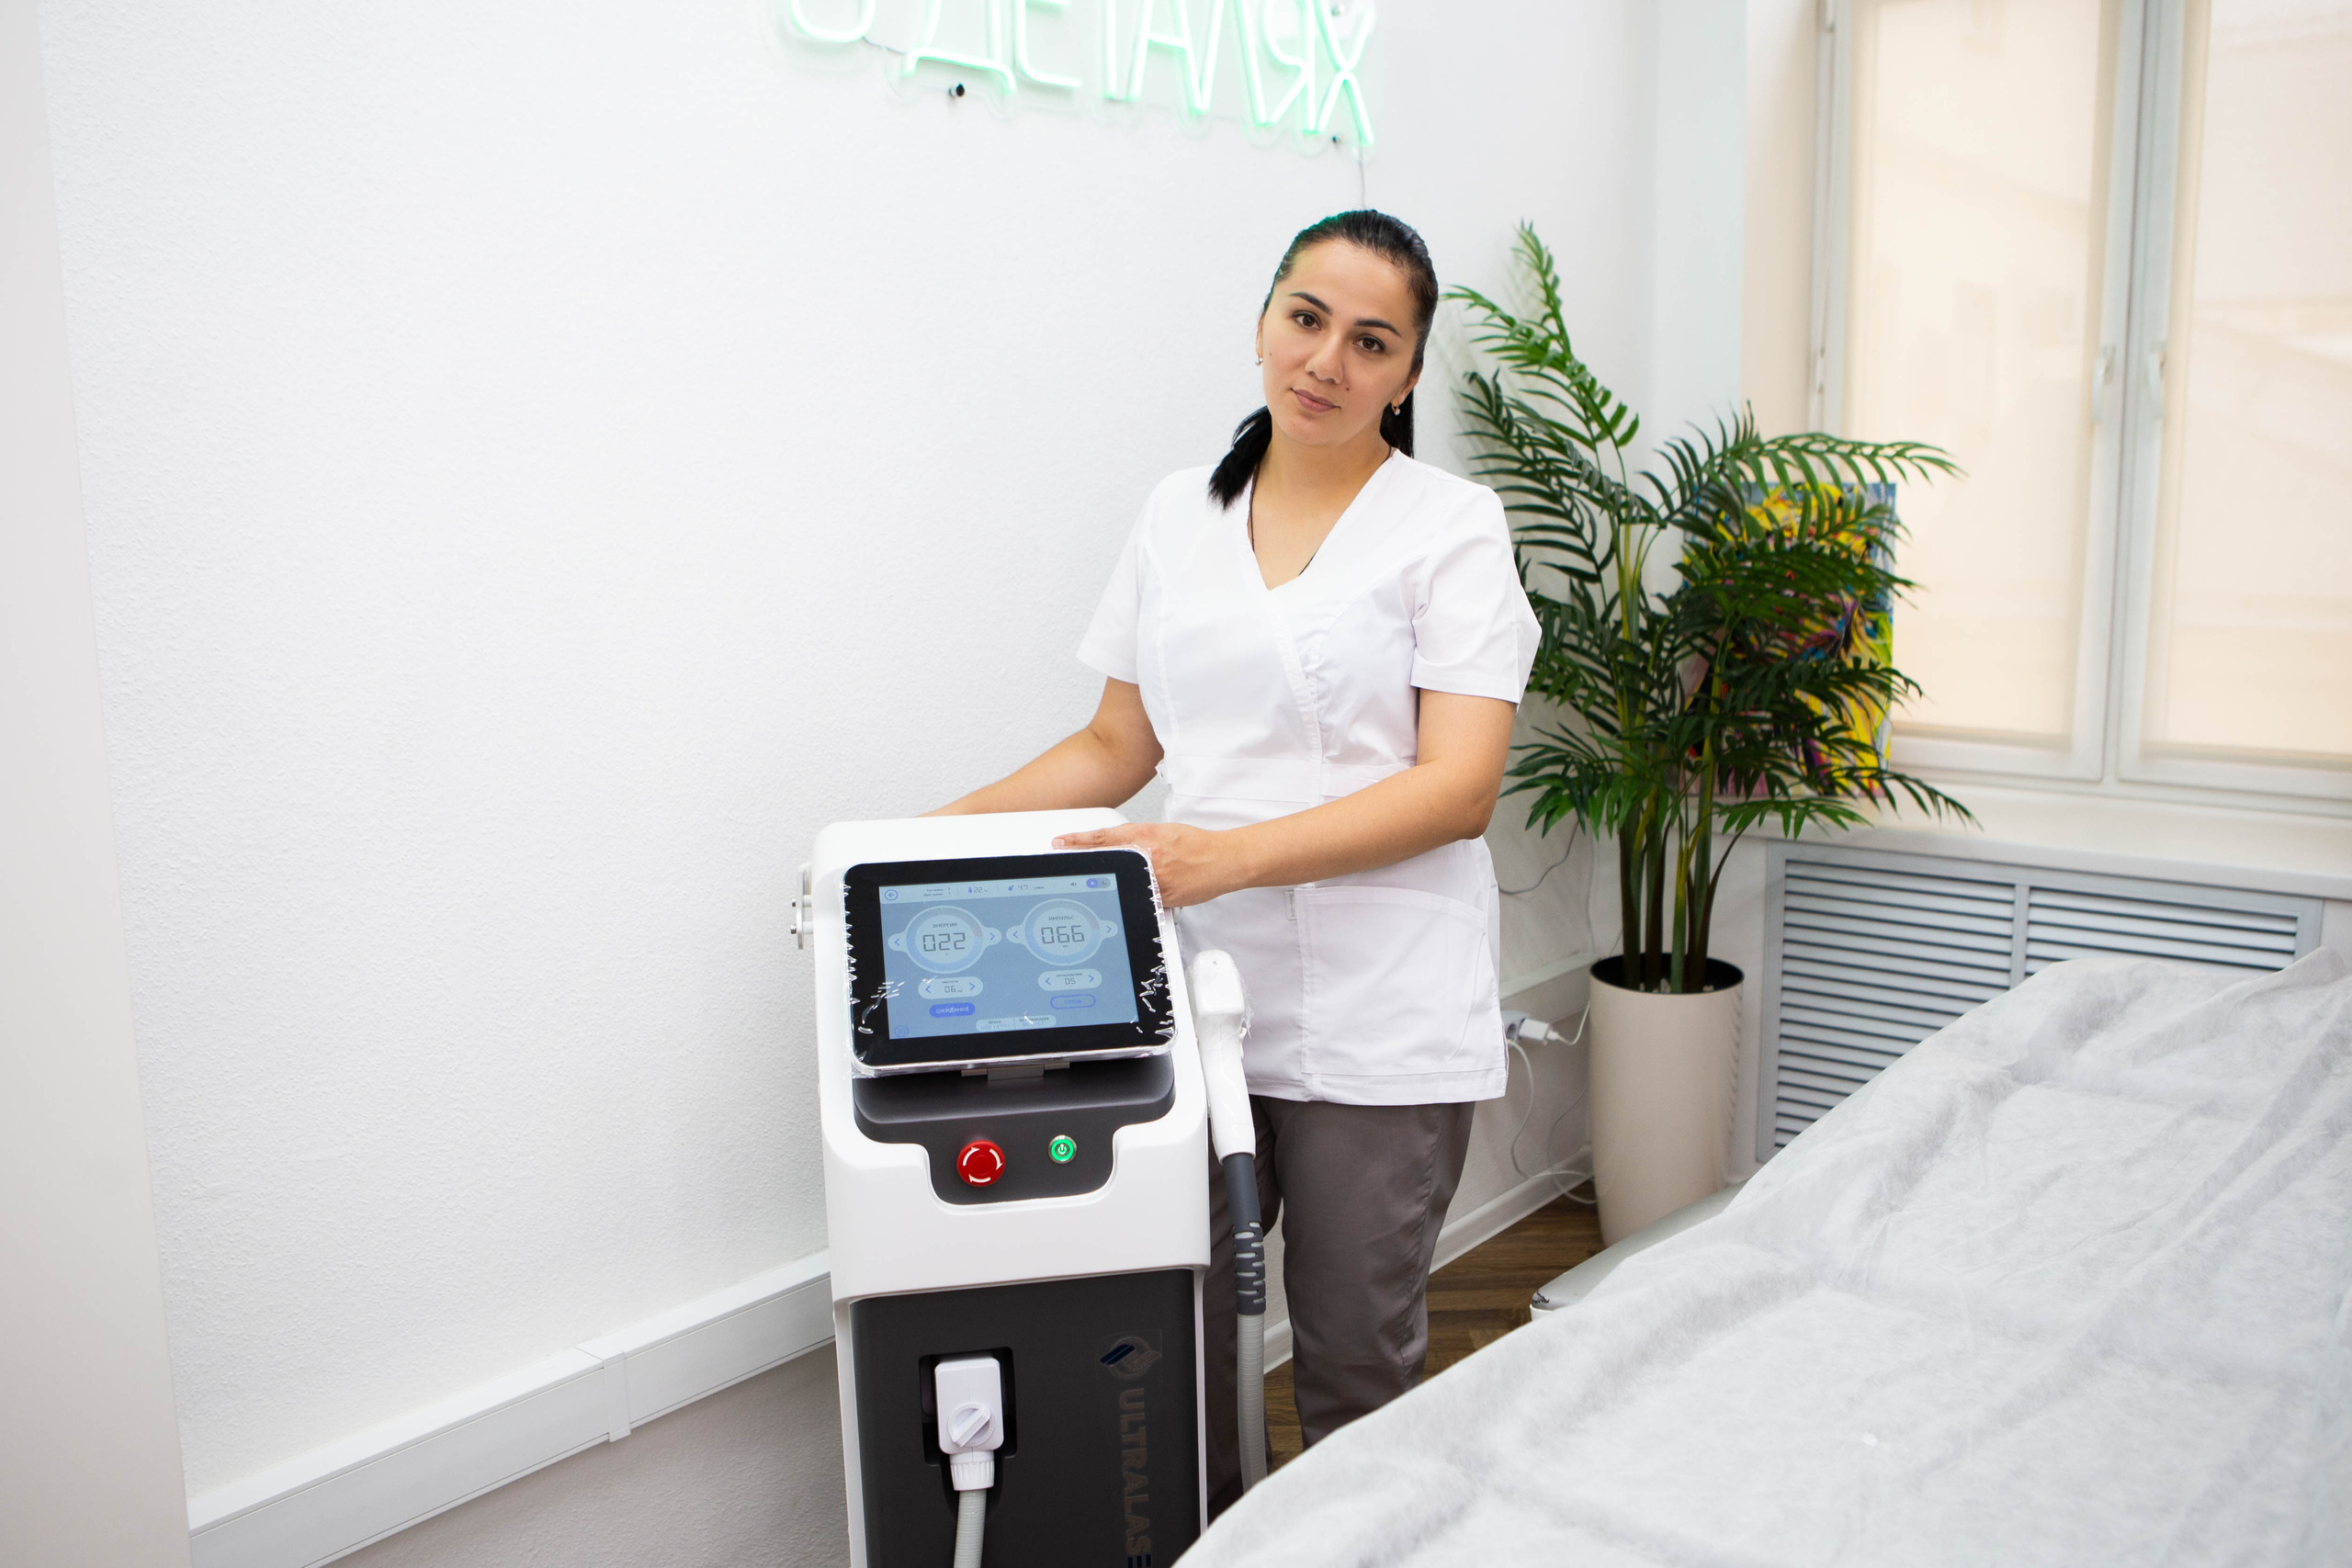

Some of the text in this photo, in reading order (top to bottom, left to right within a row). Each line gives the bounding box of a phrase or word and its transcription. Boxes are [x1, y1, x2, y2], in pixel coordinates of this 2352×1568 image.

[1041, 924, 1085, 944] 066
[922, 931, 966, 953] 022
[1064, 976, 1076, 985] 05
[944, 985, 956, 993] 06
[935, 1006, 969, 1014] ОЖИДАНИЕ
